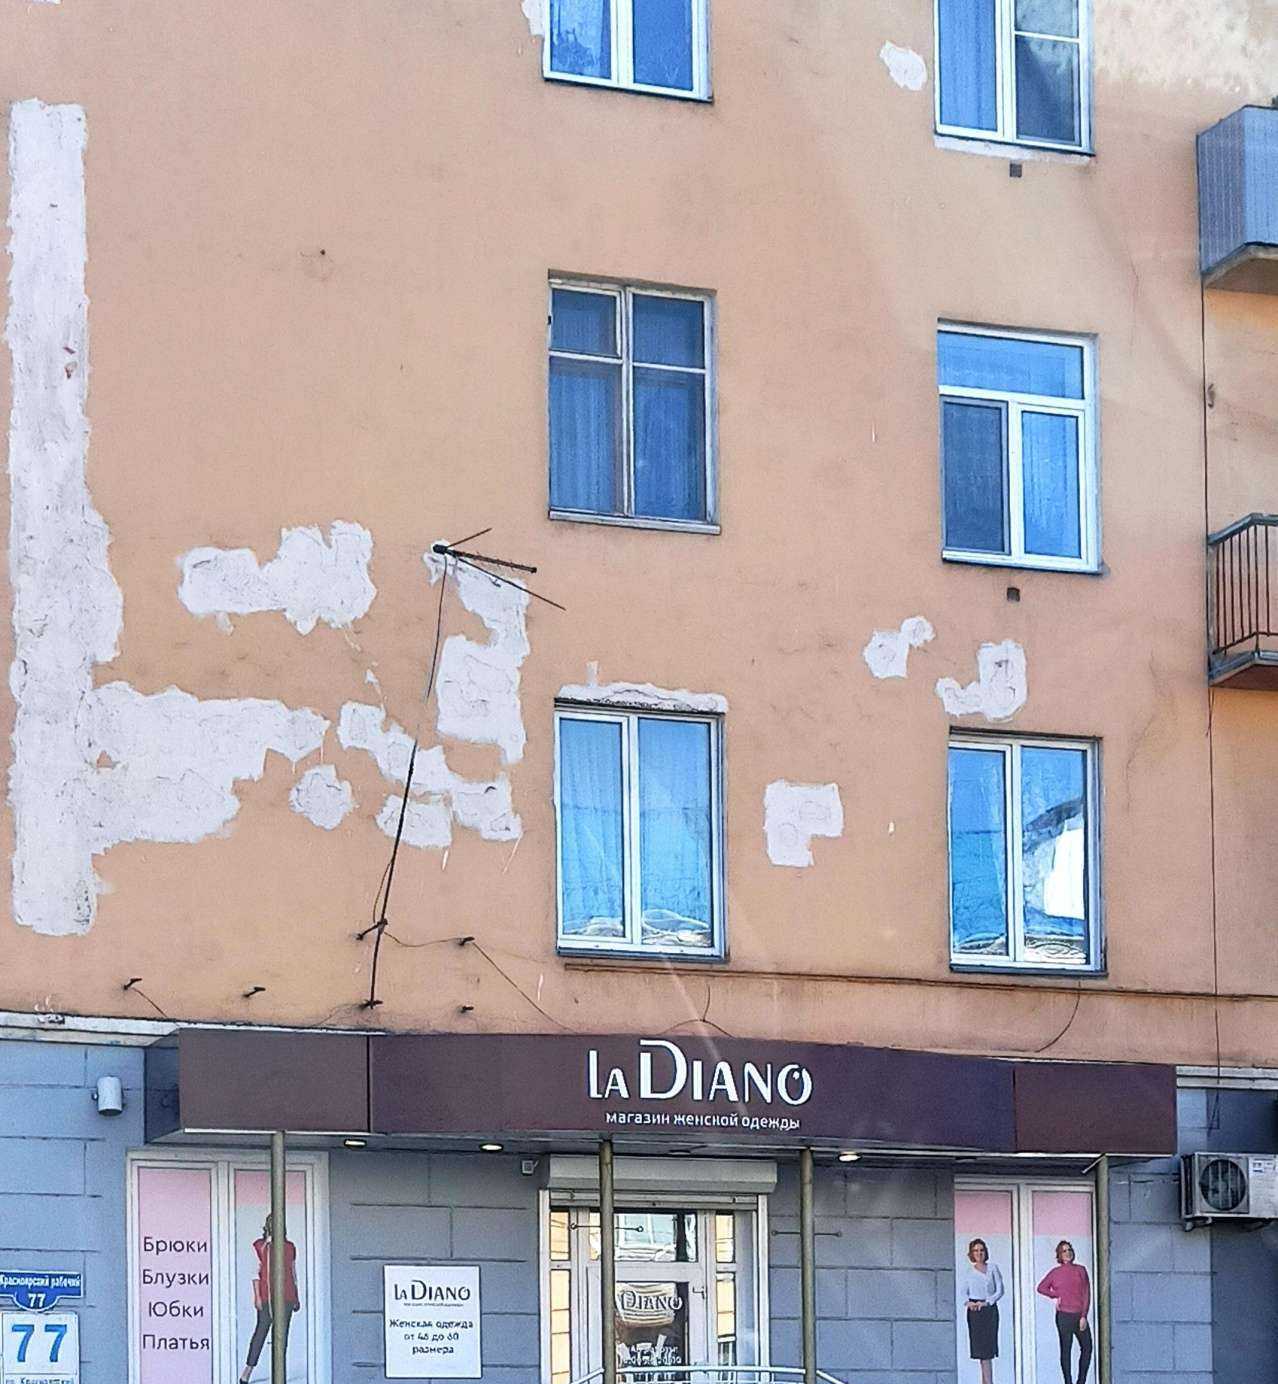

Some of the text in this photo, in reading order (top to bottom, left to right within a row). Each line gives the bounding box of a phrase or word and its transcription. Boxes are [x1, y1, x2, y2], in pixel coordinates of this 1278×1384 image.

[605, 1112, 801, 1131] магазин женской одежды
[143, 1236, 208, 1256] Брюки
[142, 1268, 209, 1289] Блузки
[27, 1293, 47, 1308] 77
[148, 1299, 204, 1318] Юбки
[389, 1319, 474, 1329] Женская одежда
[11, 1323, 68, 1363] 77
[142, 1333, 210, 1350] Платья
[412, 1346, 455, 1355] размера
